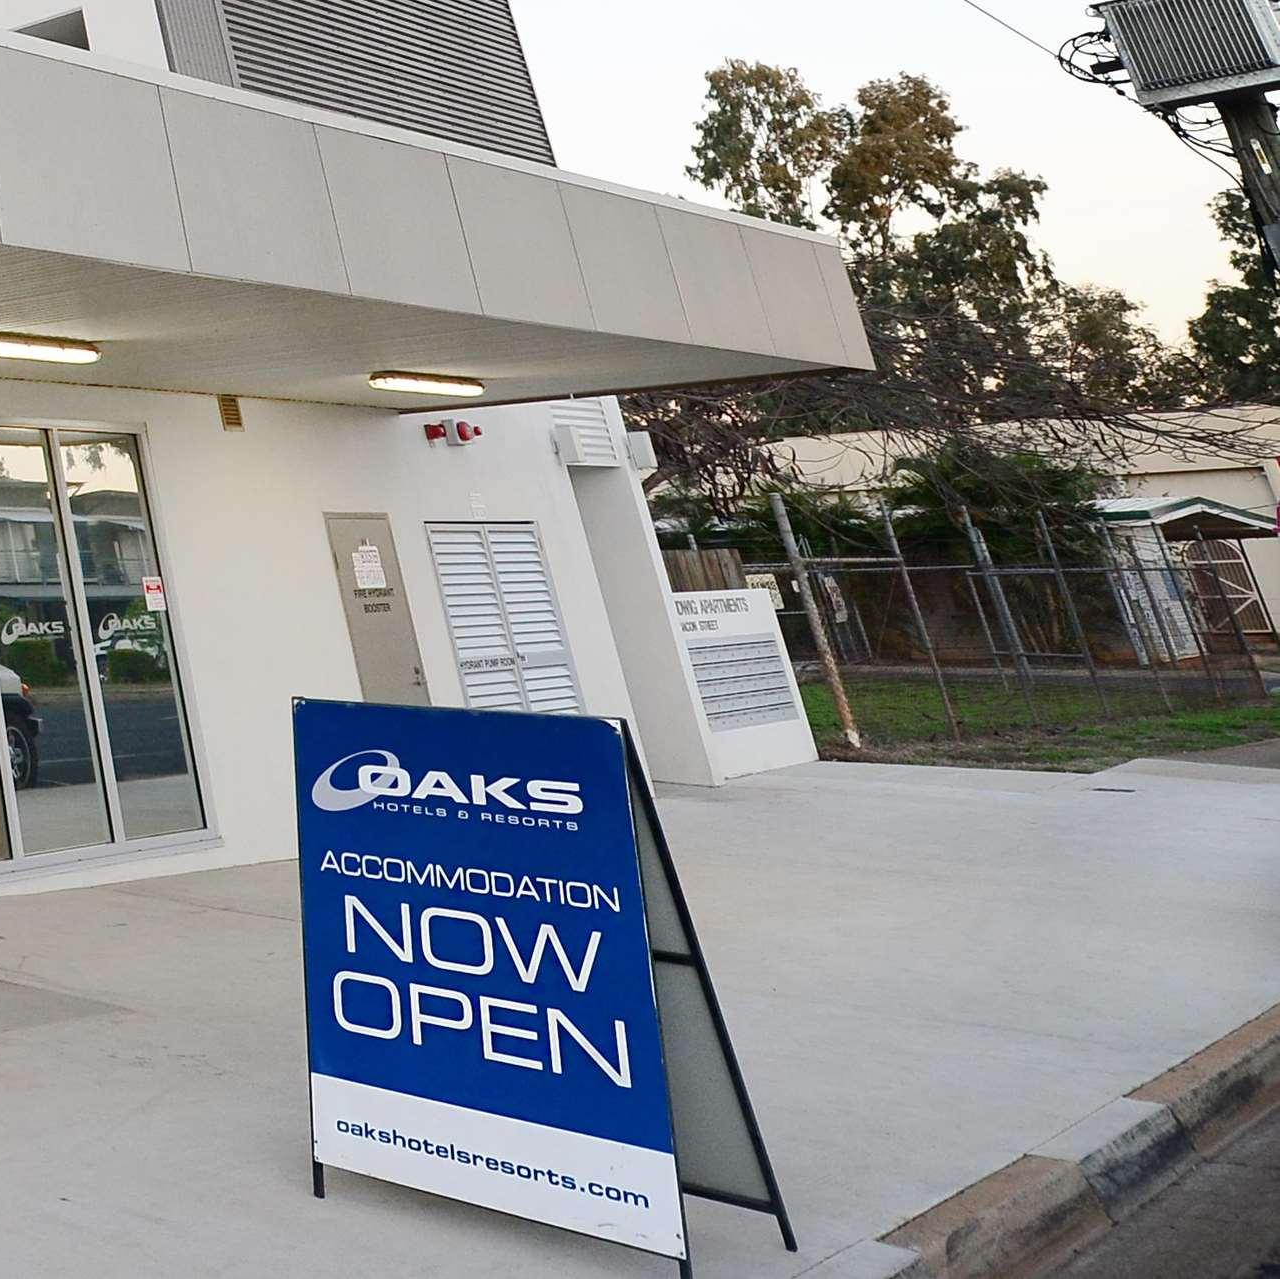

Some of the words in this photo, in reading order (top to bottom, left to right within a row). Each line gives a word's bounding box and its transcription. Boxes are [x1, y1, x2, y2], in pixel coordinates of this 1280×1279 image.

[12, 620, 66, 635] OAKS
[363, 603, 391, 614] BOOSTER
[700, 597, 749, 615] APARTMENTS
[357, 764, 585, 817] OAKS
[372, 800, 448, 818] HOTELS
[480, 812, 579, 833] RESORTS
[319, 849, 622, 914] ACCOMMODATION
[344, 894, 603, 994] NOW
[332, 970, 633, 1090] OPEN
[335, 1117, 651, 1211] oakshotelsresorts.com
